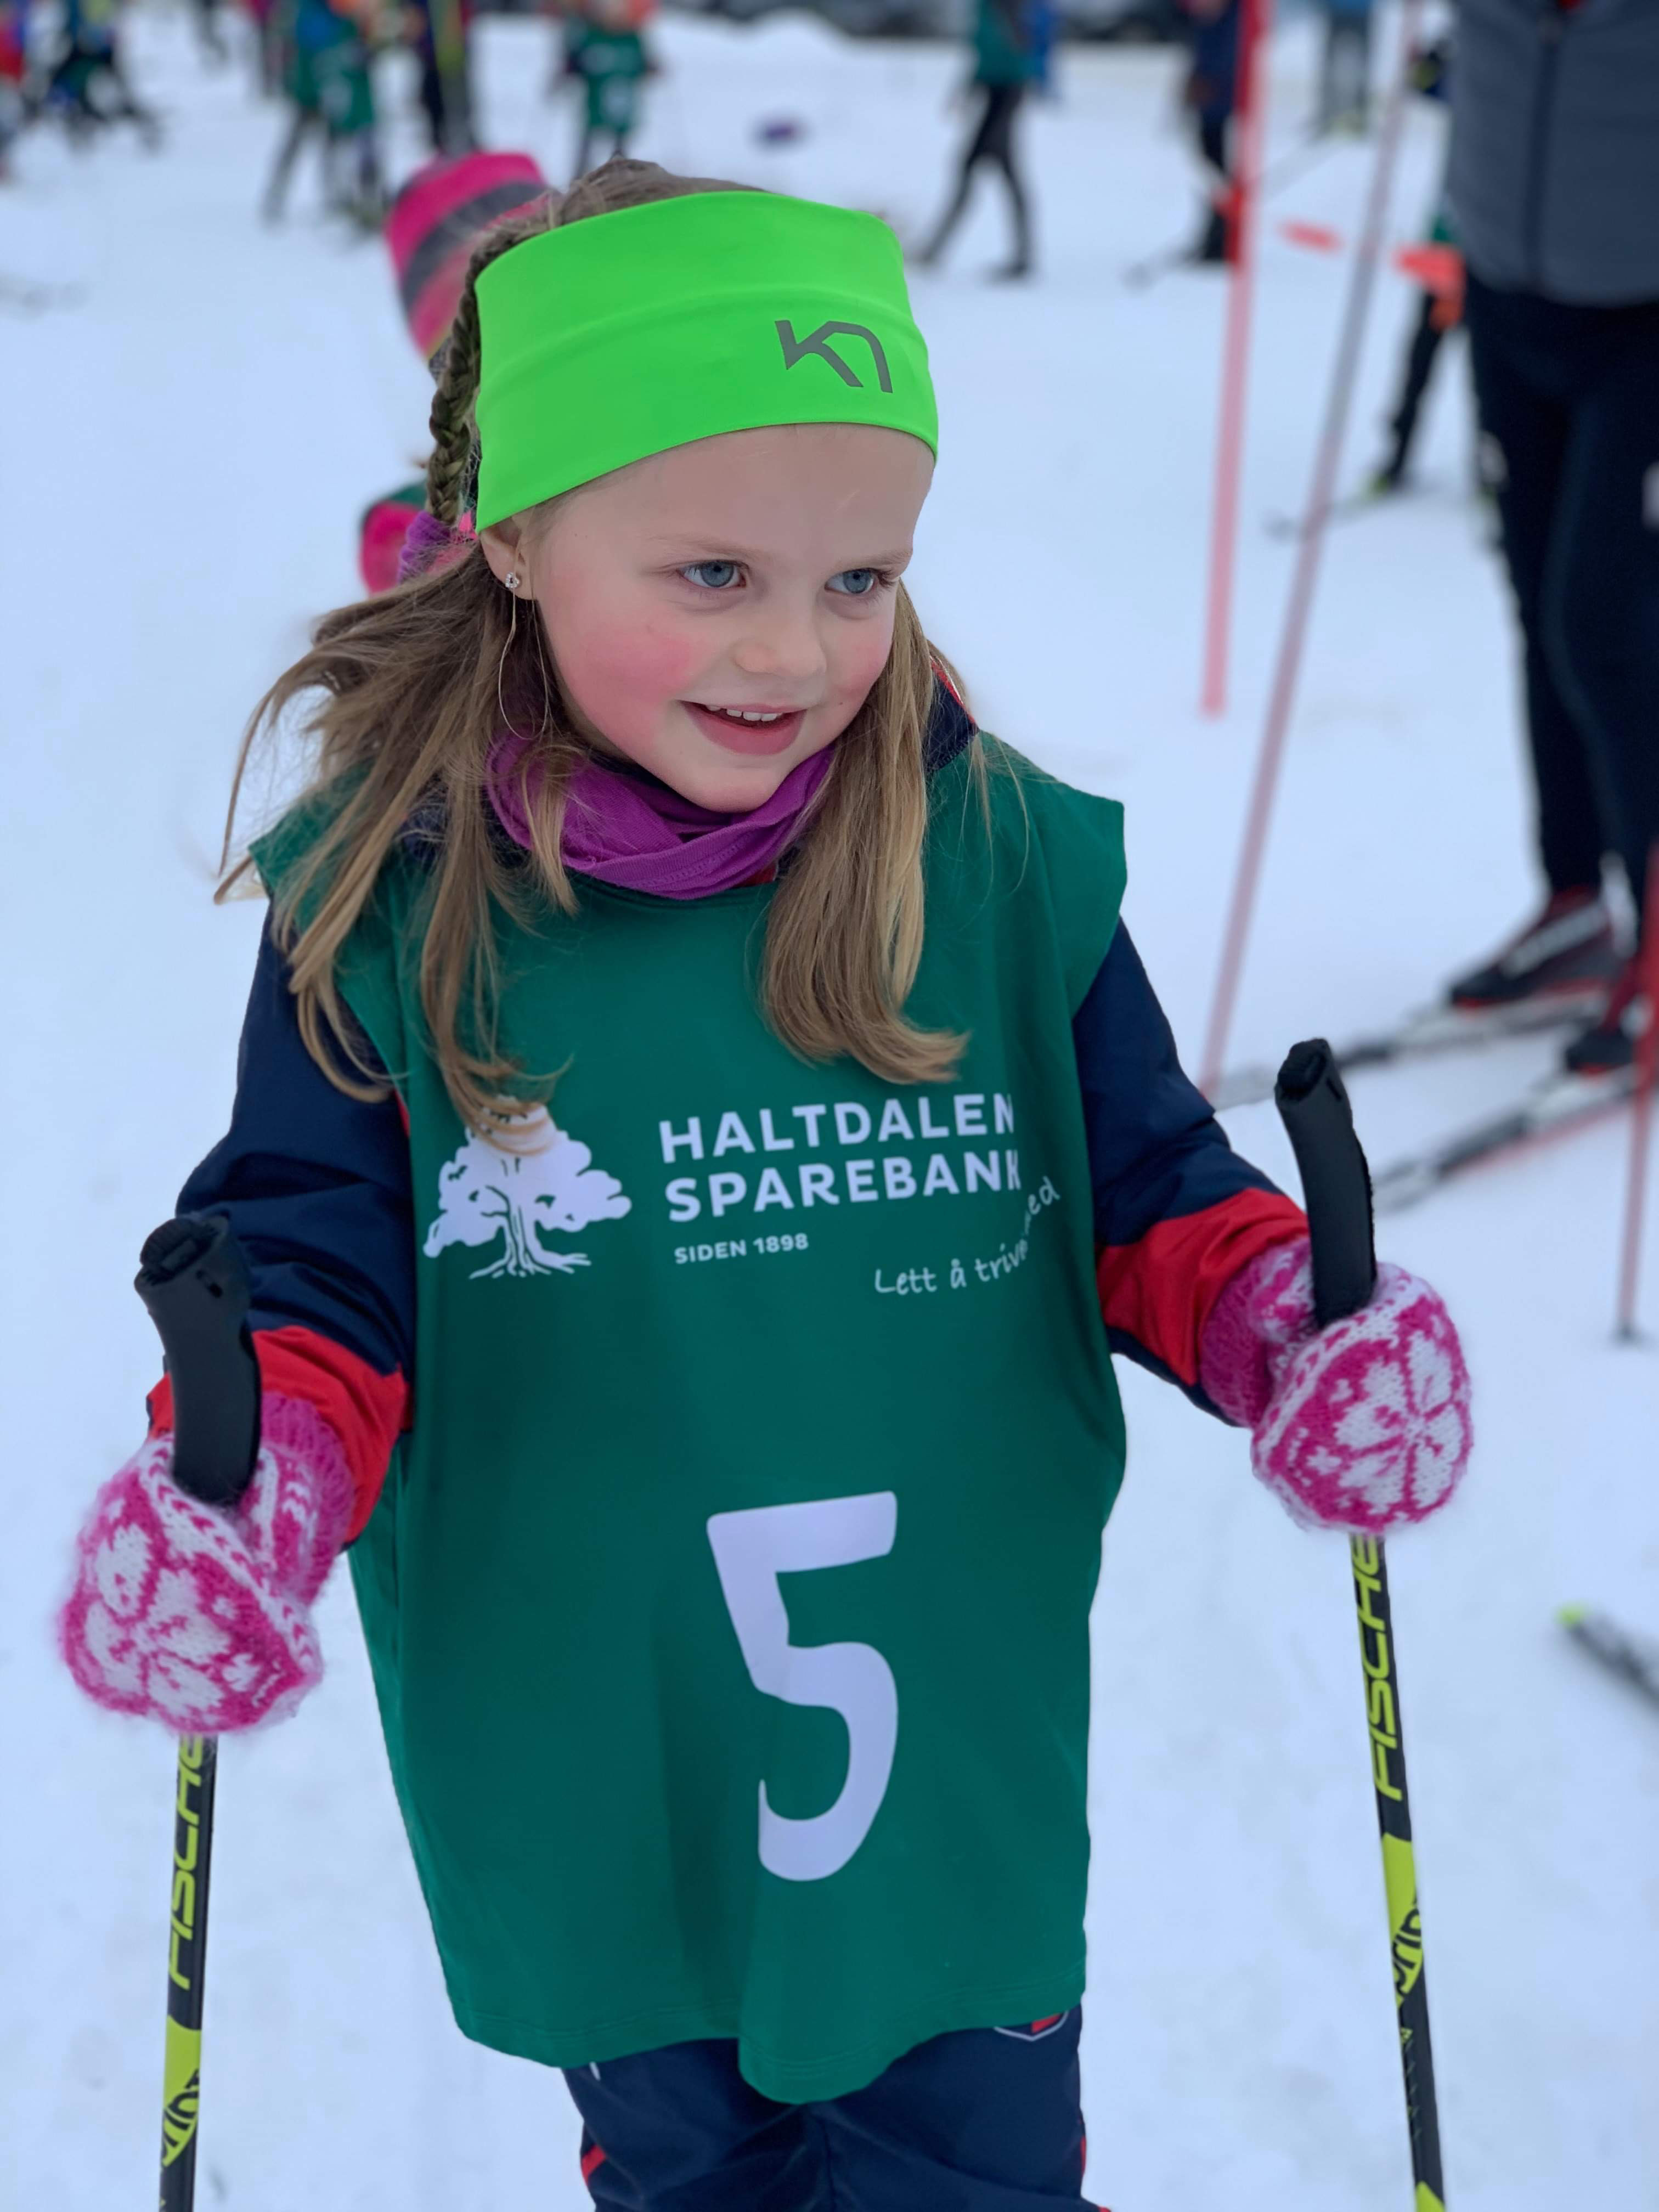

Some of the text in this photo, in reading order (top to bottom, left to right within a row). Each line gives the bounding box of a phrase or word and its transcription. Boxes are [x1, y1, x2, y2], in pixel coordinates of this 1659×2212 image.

[659, 1093, 1014, 1164] HALTDALEN
[665, 1149, 1021, 1222] SPAREBANK
[674, 1233, 809, 1264] SIDEN 1898
[874, 1267, 938, 1295] Lett
[950, 1258, 967, 1289] å
[707, 1491, 899, 1882] 5
